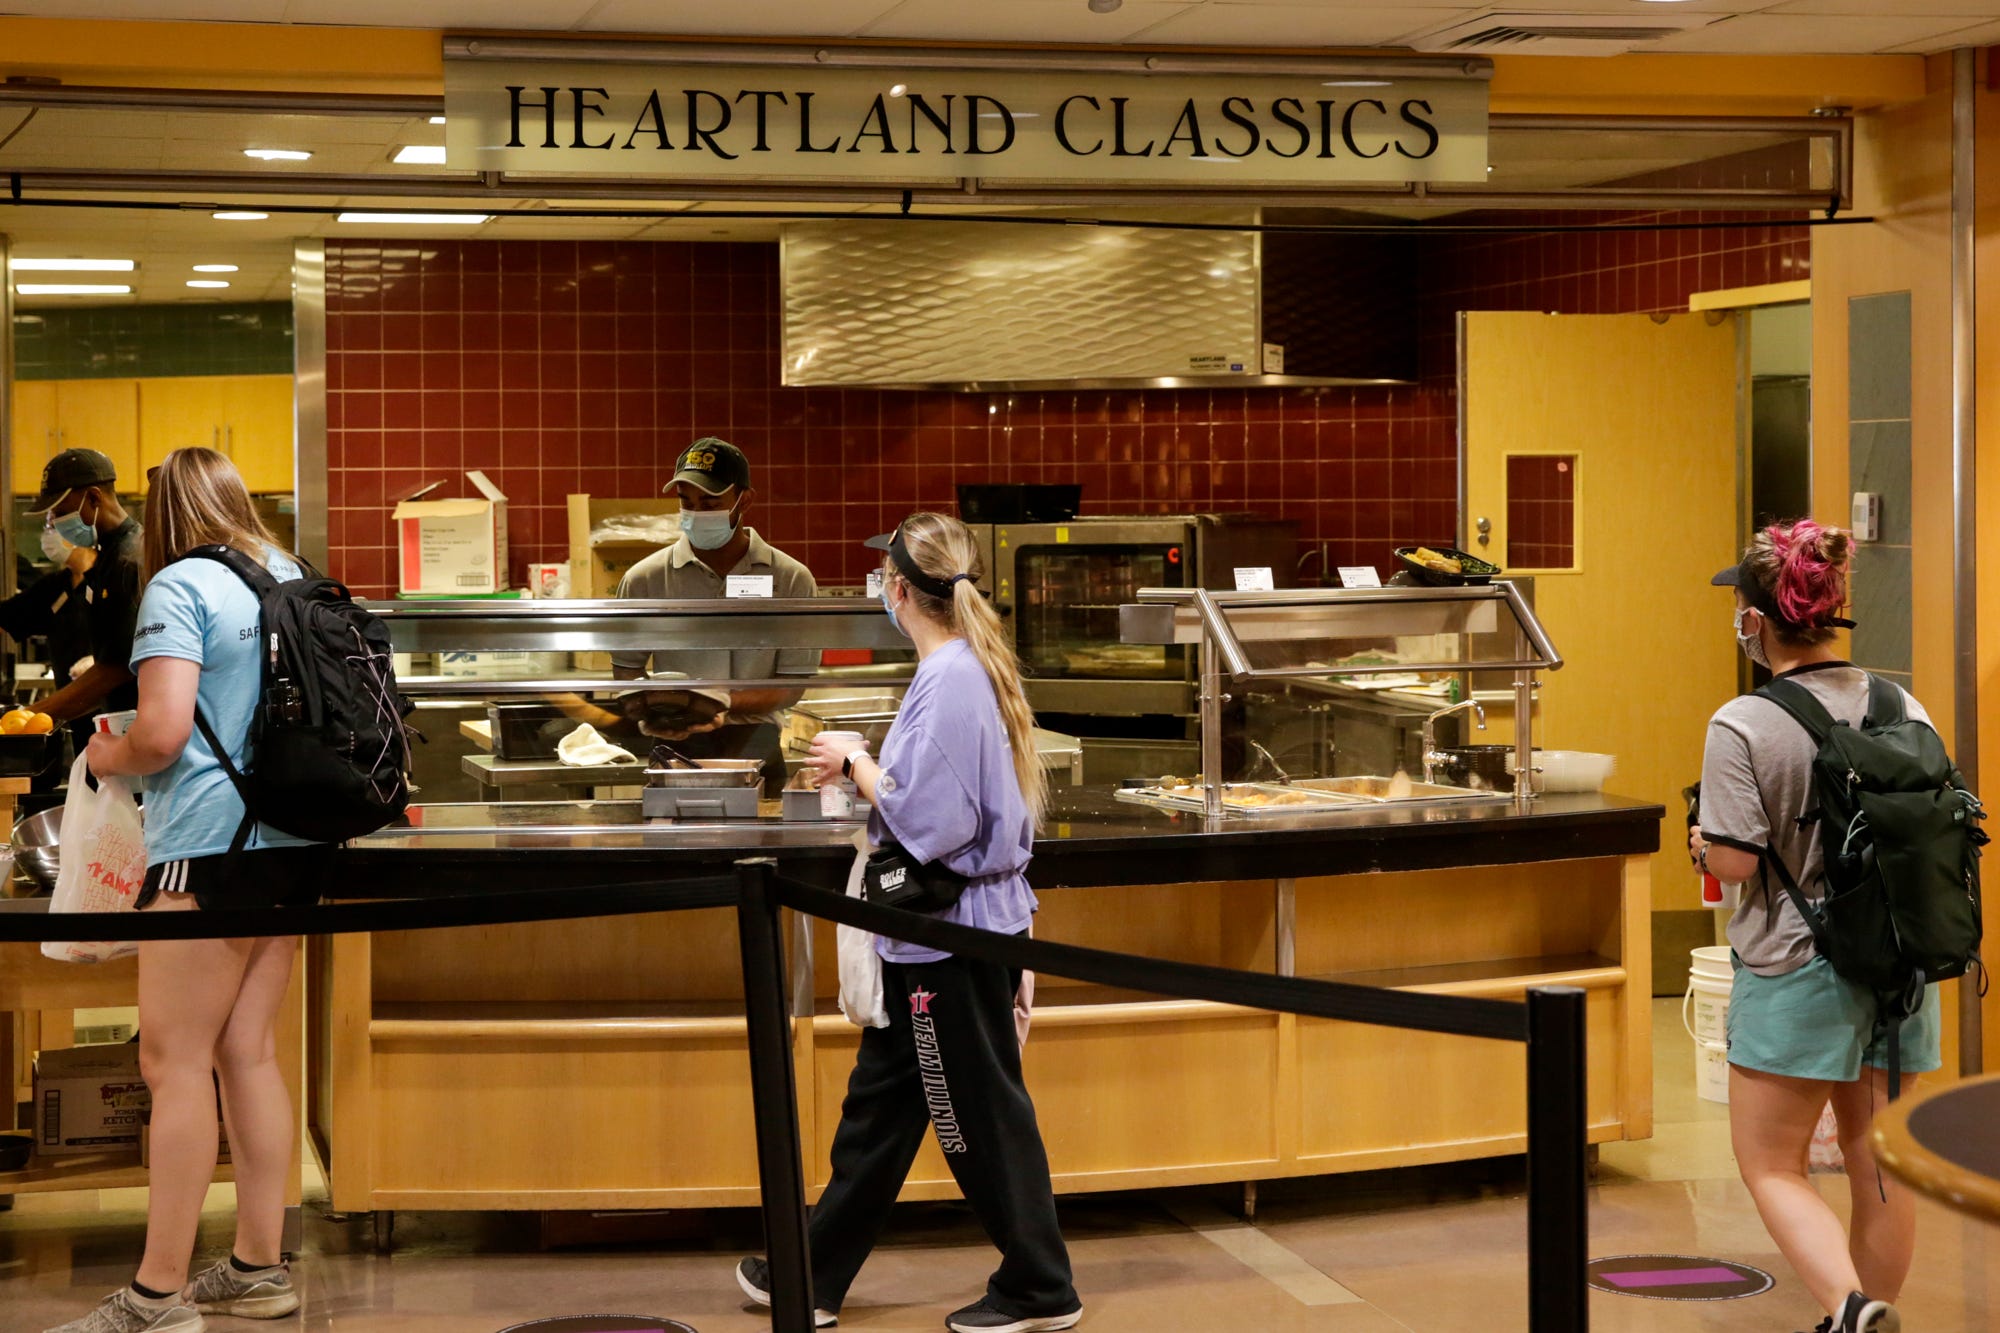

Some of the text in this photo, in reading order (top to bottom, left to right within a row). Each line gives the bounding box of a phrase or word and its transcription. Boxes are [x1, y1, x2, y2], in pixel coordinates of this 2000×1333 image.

[505, 86, 1439, 160] HEARTLAND CLASSICS
[911, 1015, 967, 1153] TEAM ILLINOIS
